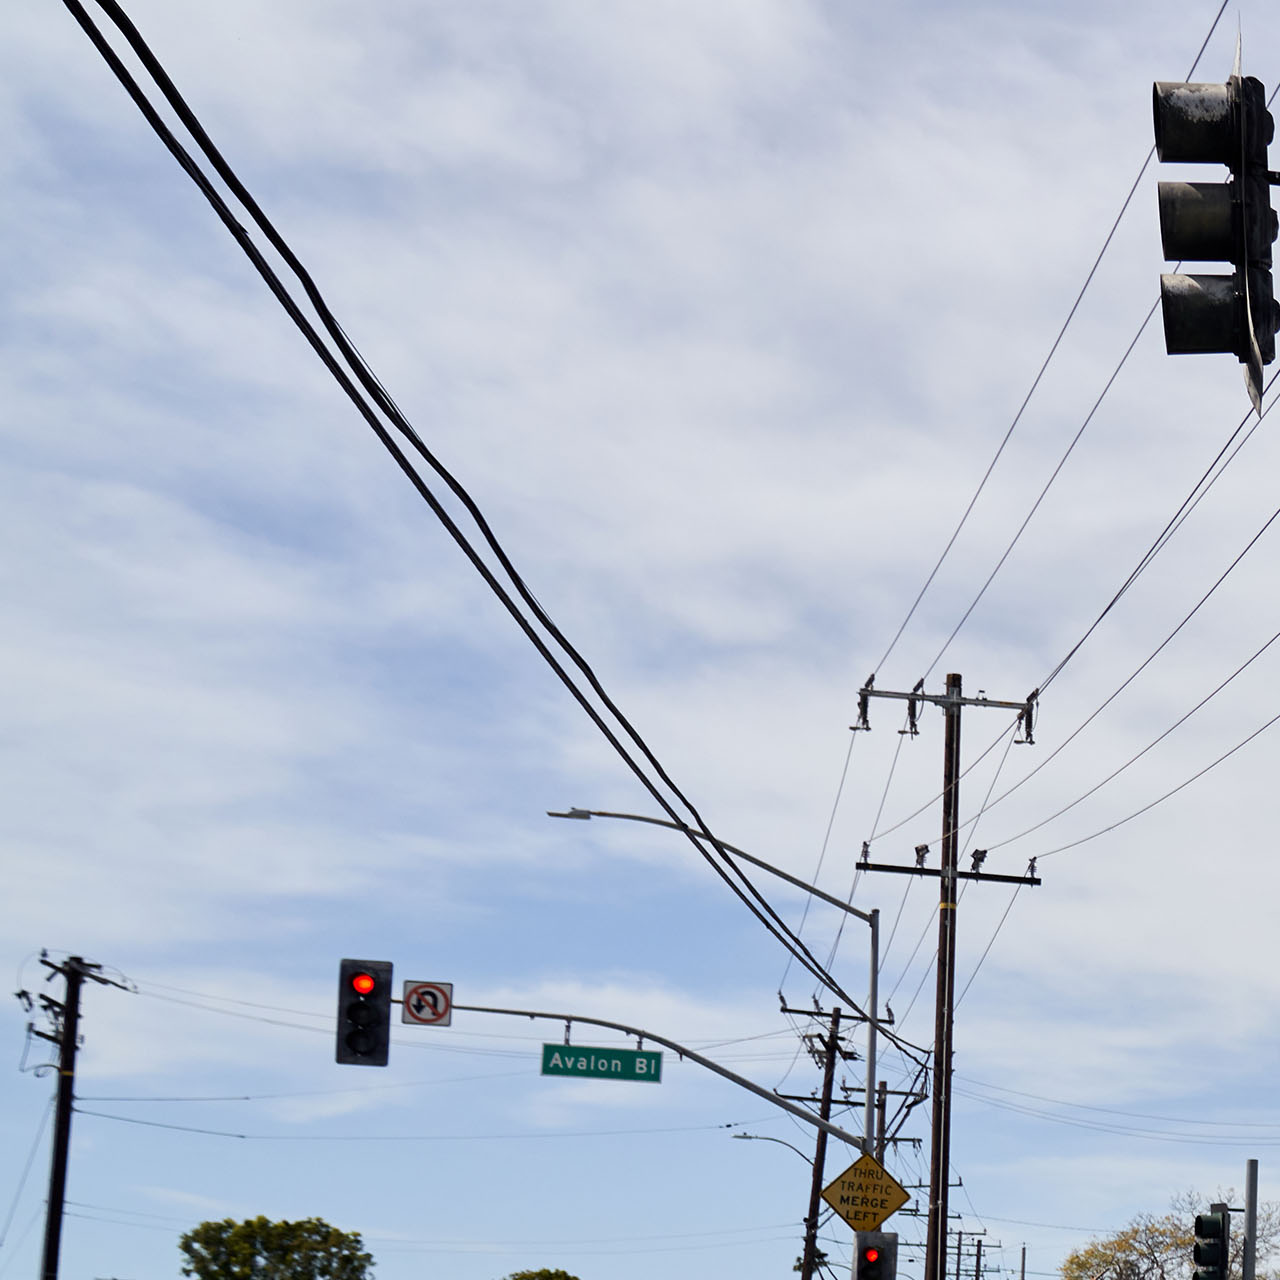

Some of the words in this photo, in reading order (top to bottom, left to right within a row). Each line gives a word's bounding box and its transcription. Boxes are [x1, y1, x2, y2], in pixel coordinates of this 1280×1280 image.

[548, 1052, 622, 1073] Avalon
[635, 1057, 656, 1075] Bl
[853, 1167, 885, 1180] THRU
[840, 1180, 893, 1196] TRAFFIC
[840, 1194, 889, 1210] MERGE
[845, 1209, 880, 1224] LEFT
